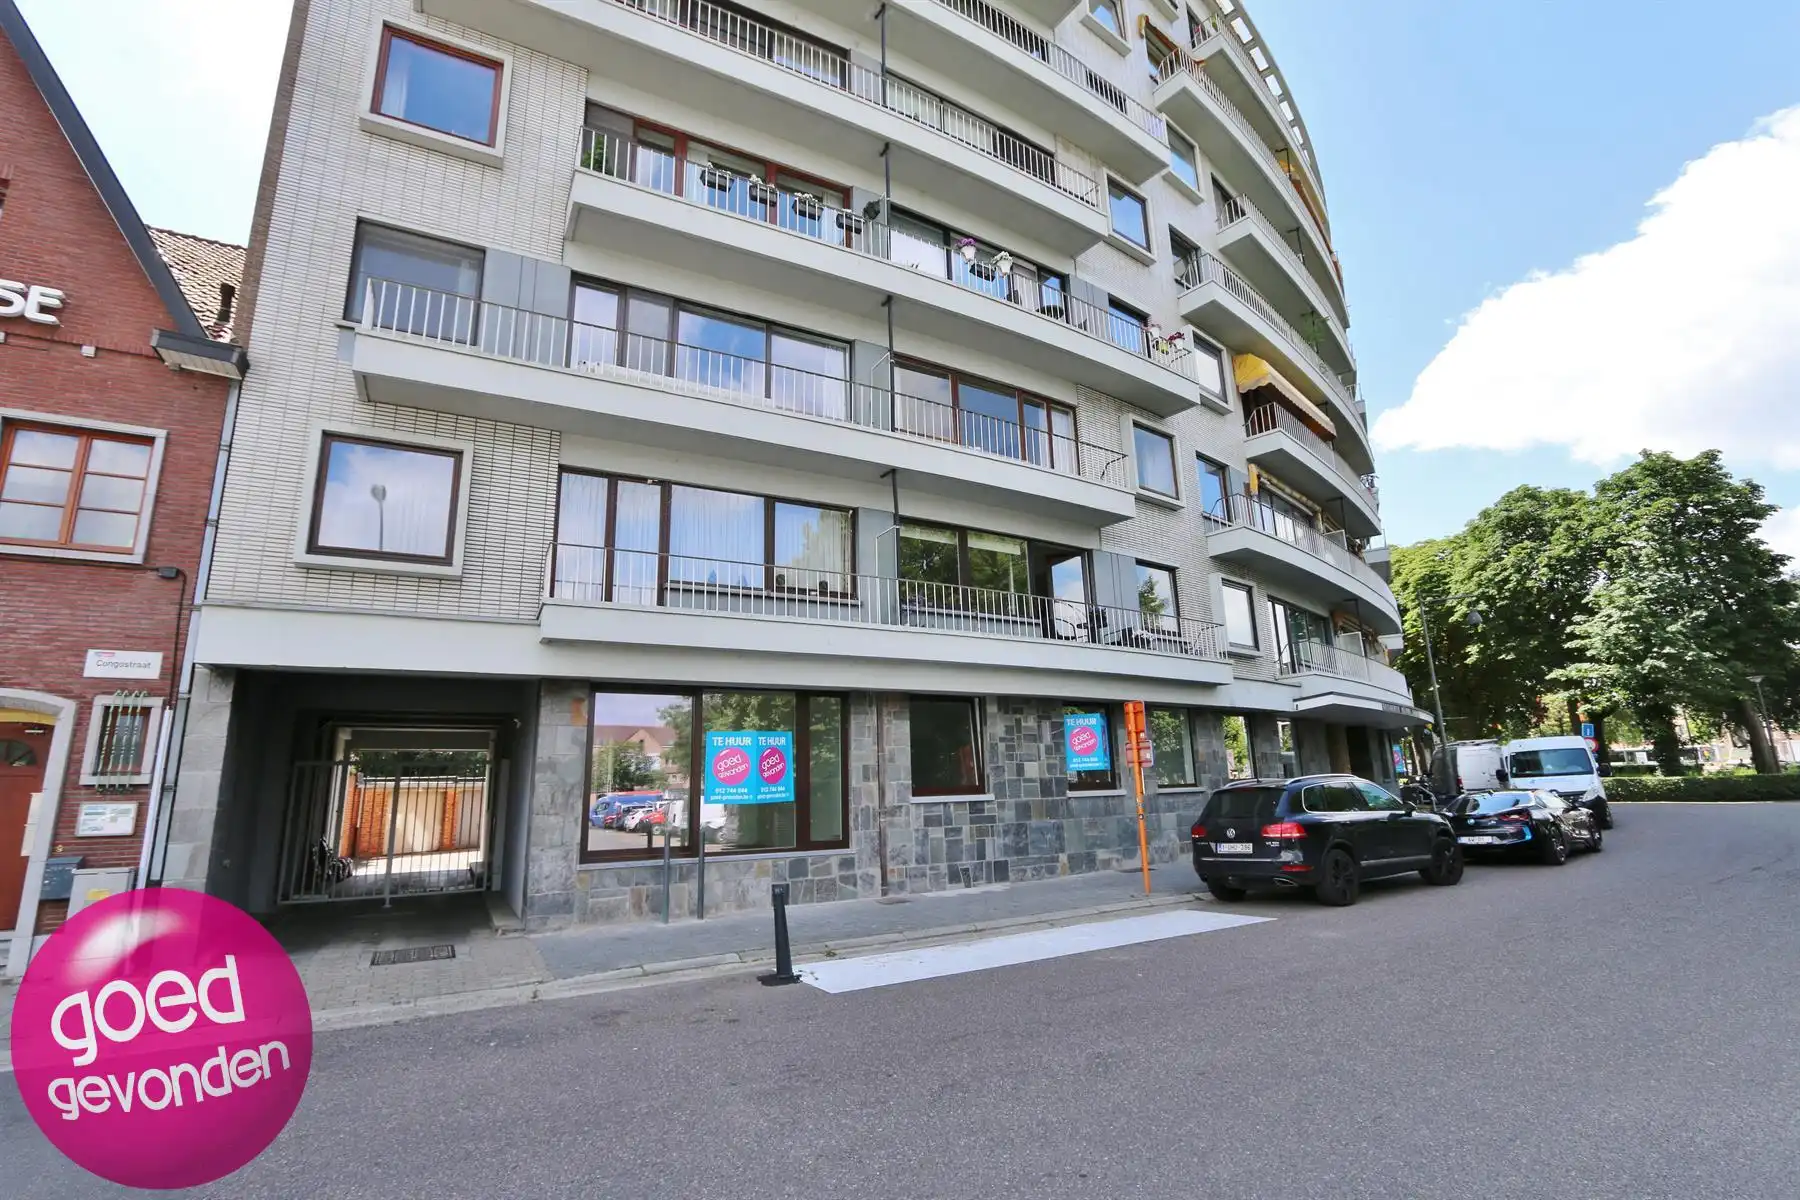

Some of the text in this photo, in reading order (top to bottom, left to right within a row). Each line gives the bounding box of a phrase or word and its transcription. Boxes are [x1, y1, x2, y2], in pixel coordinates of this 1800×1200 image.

[96, 659, 151, 669] Congostraat
[1076, 718, 1097, 726] HUUR
[712, 736, 752, 746] TE HUUR
[758, 736, 786, 746] TE HUUR
[717, 754, 742, 771] goed
[761, 754, 780, 771] goed
